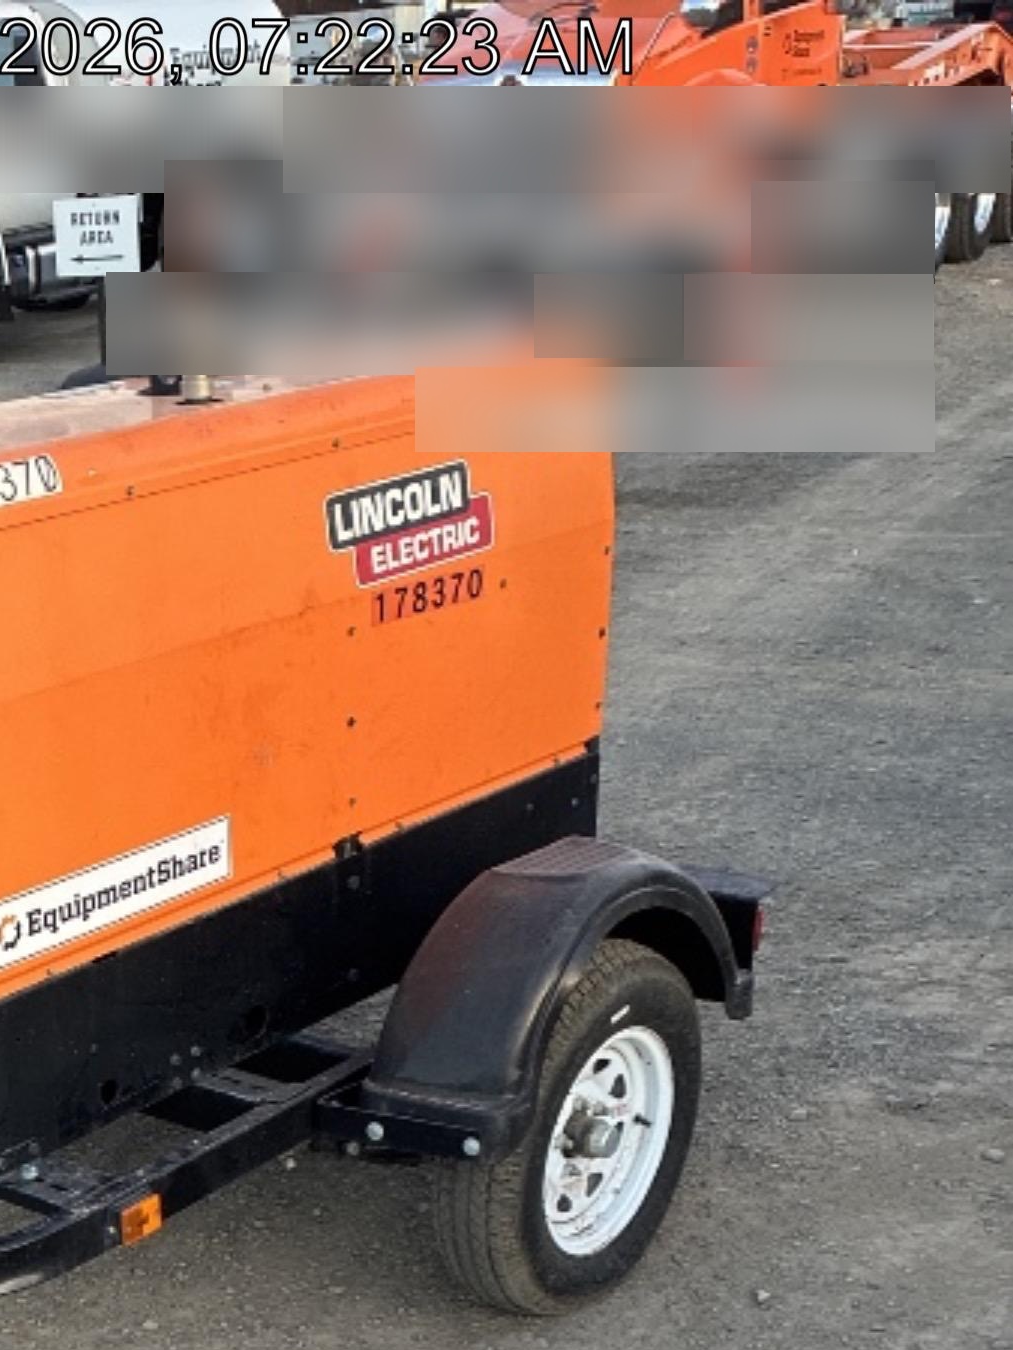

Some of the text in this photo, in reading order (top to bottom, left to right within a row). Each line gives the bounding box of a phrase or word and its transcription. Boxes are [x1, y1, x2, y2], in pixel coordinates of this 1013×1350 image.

[70, 210, 120, 227] RETURN
[79, 230, 114, 247] AREA
[334, 470, 463, 543] LINCOLN
[370, 515, 481, 575] ELECTRIC
[375, 568, 483, 624] 178370
[26, 844, 221, 937] EquipmentShare
